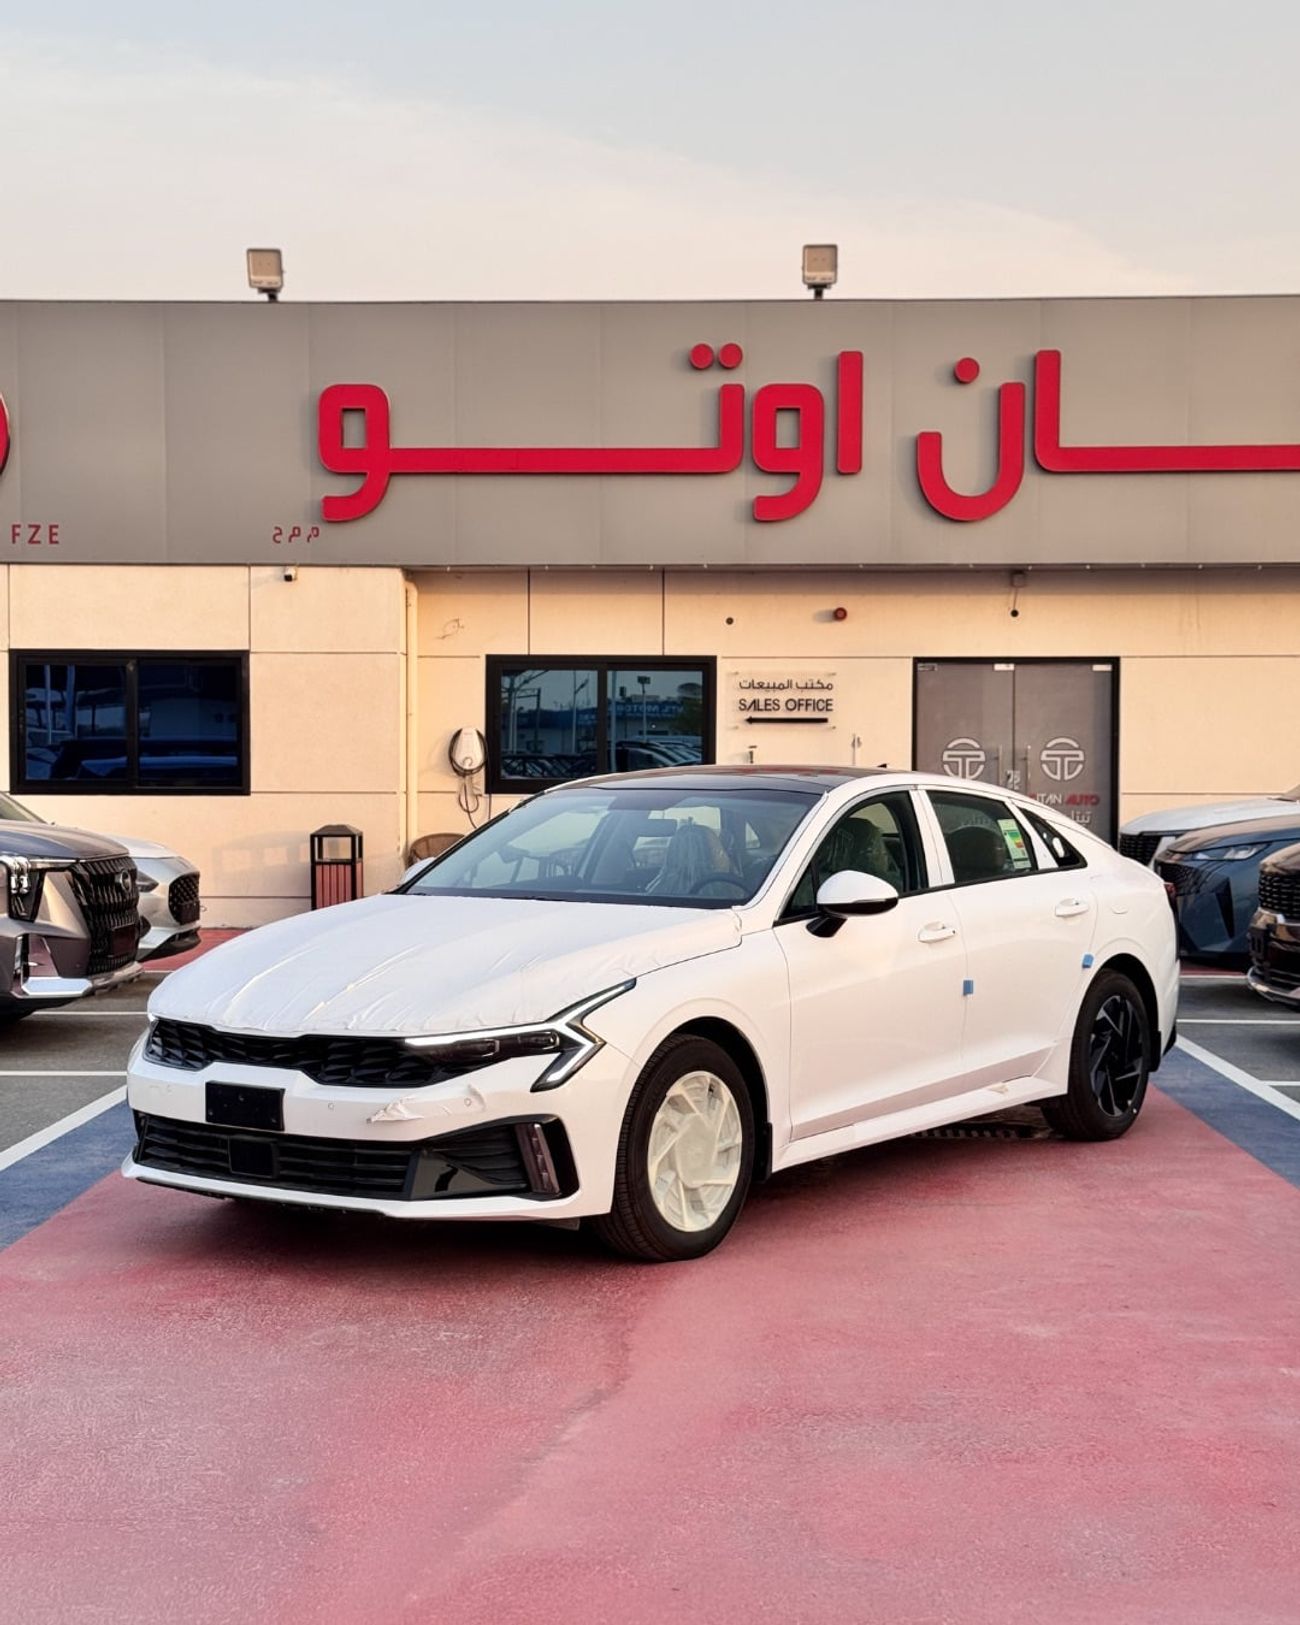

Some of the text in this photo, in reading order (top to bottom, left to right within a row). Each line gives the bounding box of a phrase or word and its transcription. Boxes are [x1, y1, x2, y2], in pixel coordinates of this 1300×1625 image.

[11, 525, 60, 544] FZE
[739, 679, 834, 693] مكتب المبيعات
[738, 698, 834, 712] SALES OFFICE
